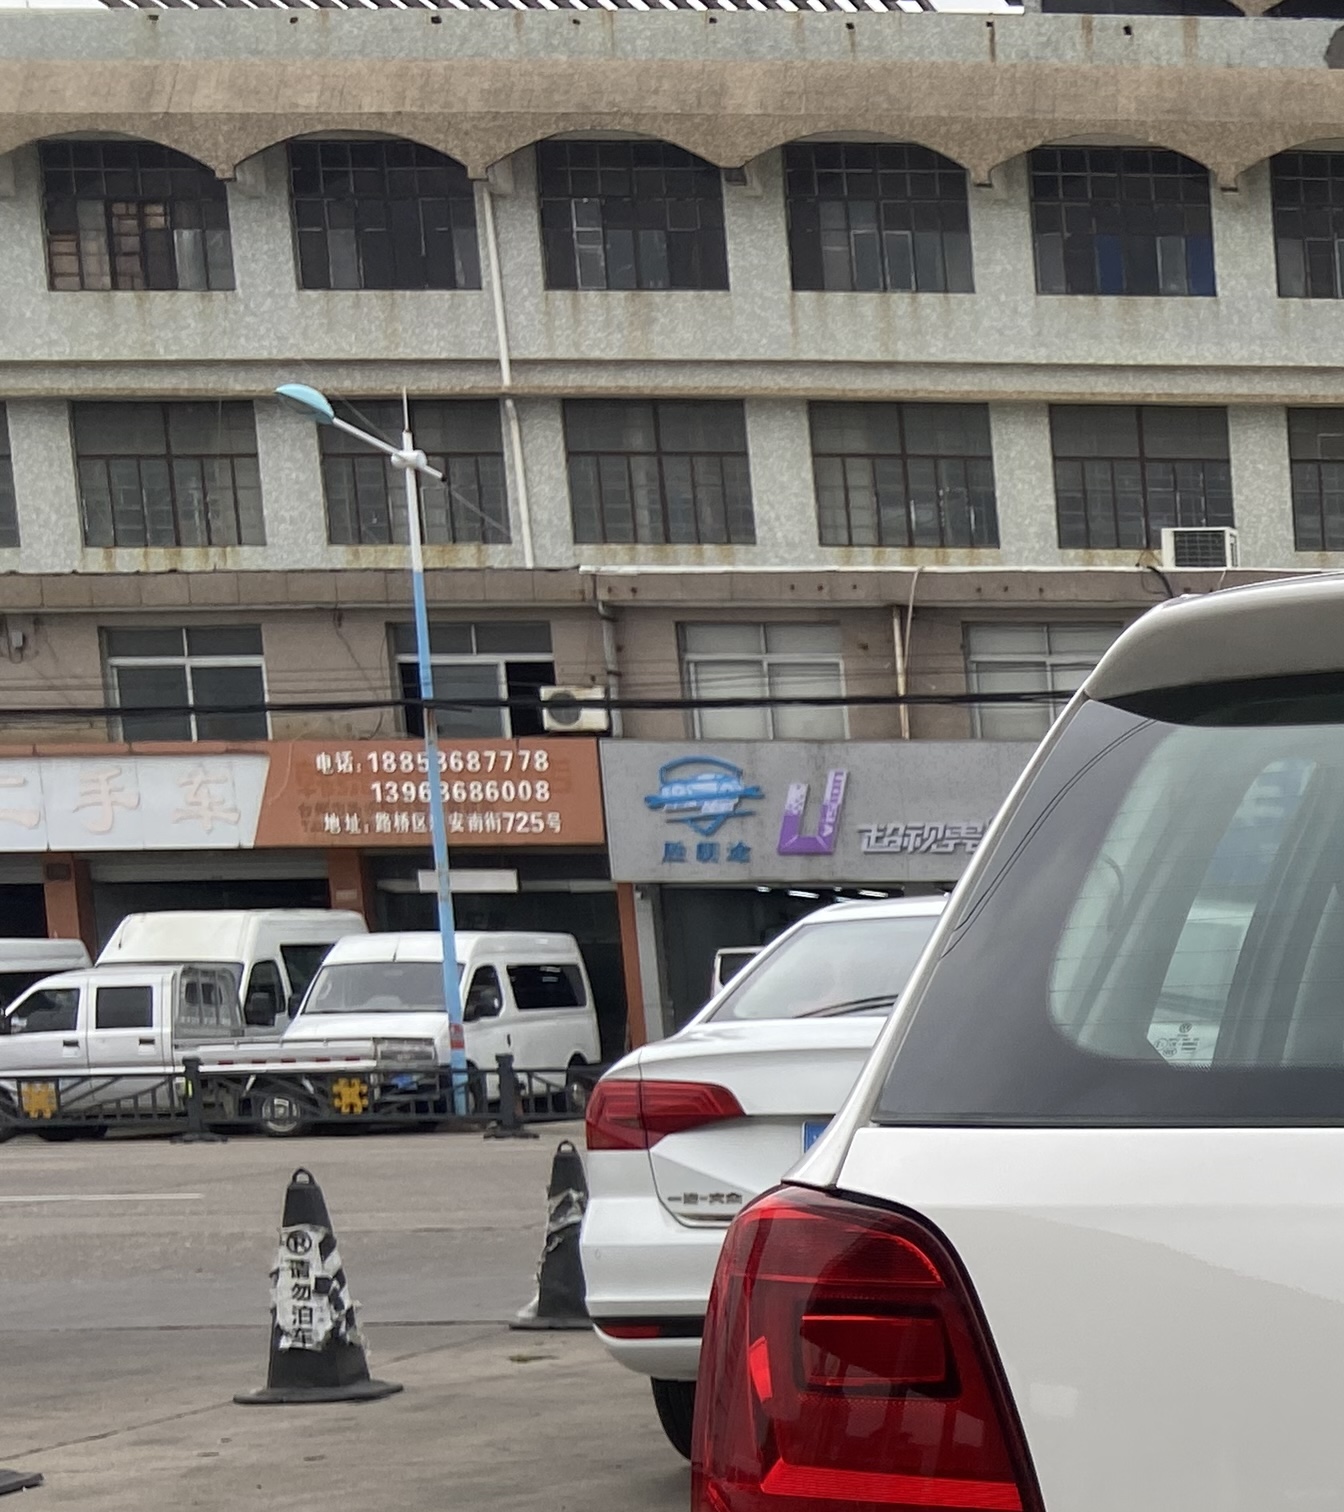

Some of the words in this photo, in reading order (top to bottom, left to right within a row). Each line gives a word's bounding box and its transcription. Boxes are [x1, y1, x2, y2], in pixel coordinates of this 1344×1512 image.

[323, 811, 562, 834] 地址:路桥区安南街725号
